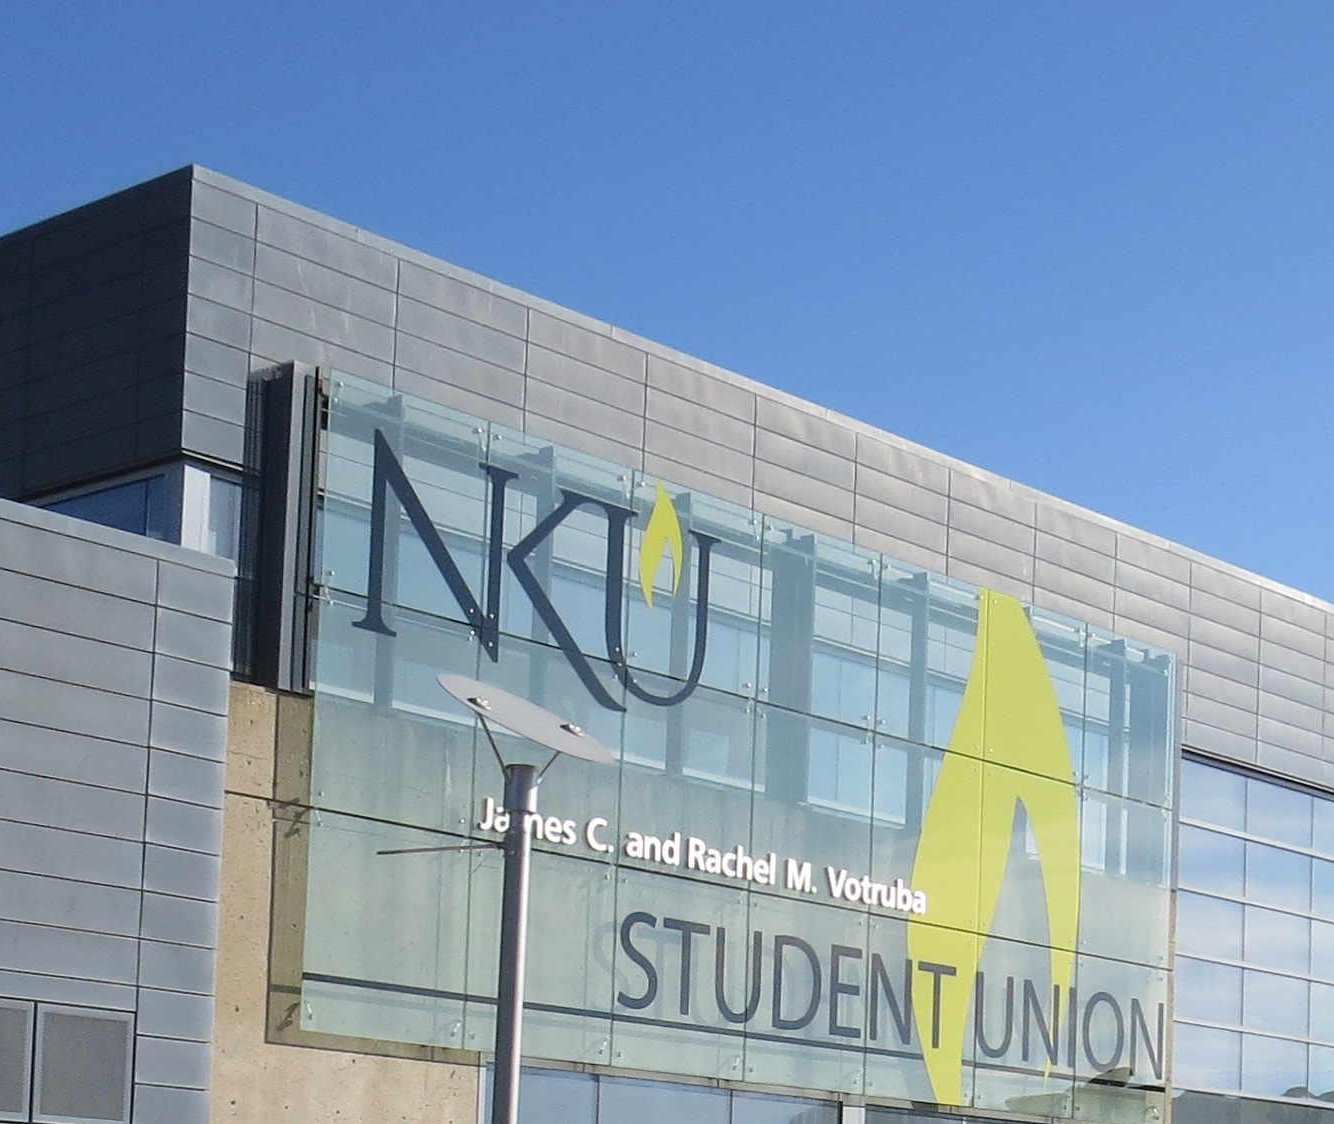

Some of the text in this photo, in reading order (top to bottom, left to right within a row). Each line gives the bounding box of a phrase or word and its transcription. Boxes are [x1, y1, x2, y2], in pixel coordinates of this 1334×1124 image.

[352, 428, 721, 713] NKU
[586, 816, 615, 854] C.
[625, 831, 682, 867] and
[686, 836, 777, 886] Rachel
[785, 857, 818, 894] M.
[826, 865, 927, 915] Votruba
[617, 911, 1165, 1081] STUDENT UNION
